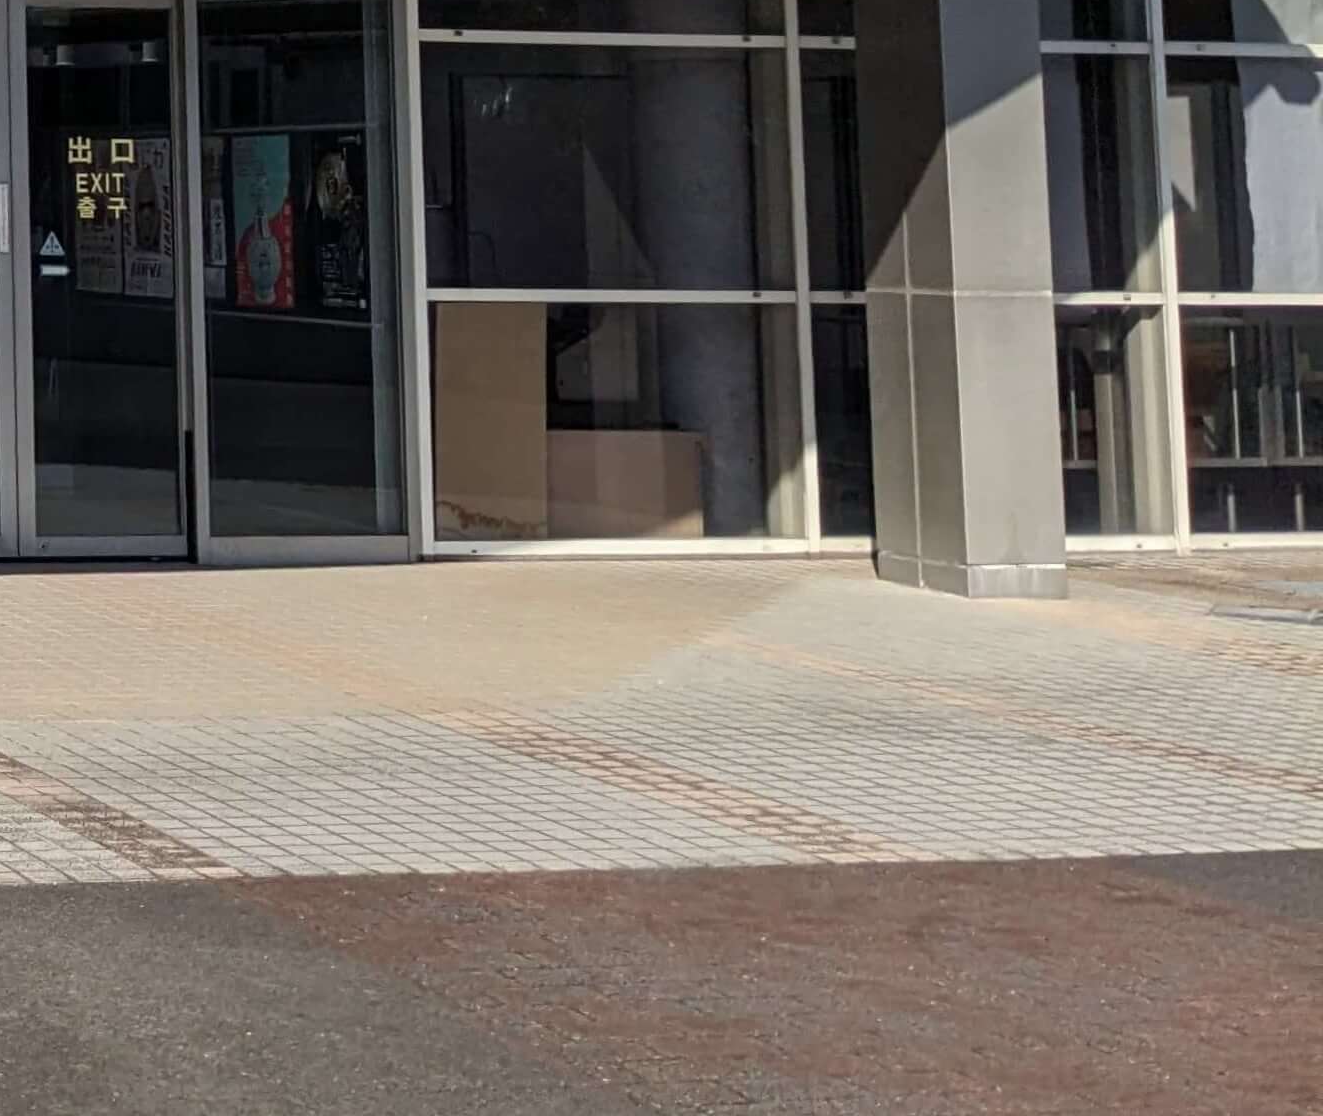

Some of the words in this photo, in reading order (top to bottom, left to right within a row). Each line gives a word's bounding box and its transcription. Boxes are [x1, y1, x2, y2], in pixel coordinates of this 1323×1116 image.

[67, 135, 135, 165] 出口
[75, 172, 125, 194] EXIT
[75, 197, 128, 220] 출구
